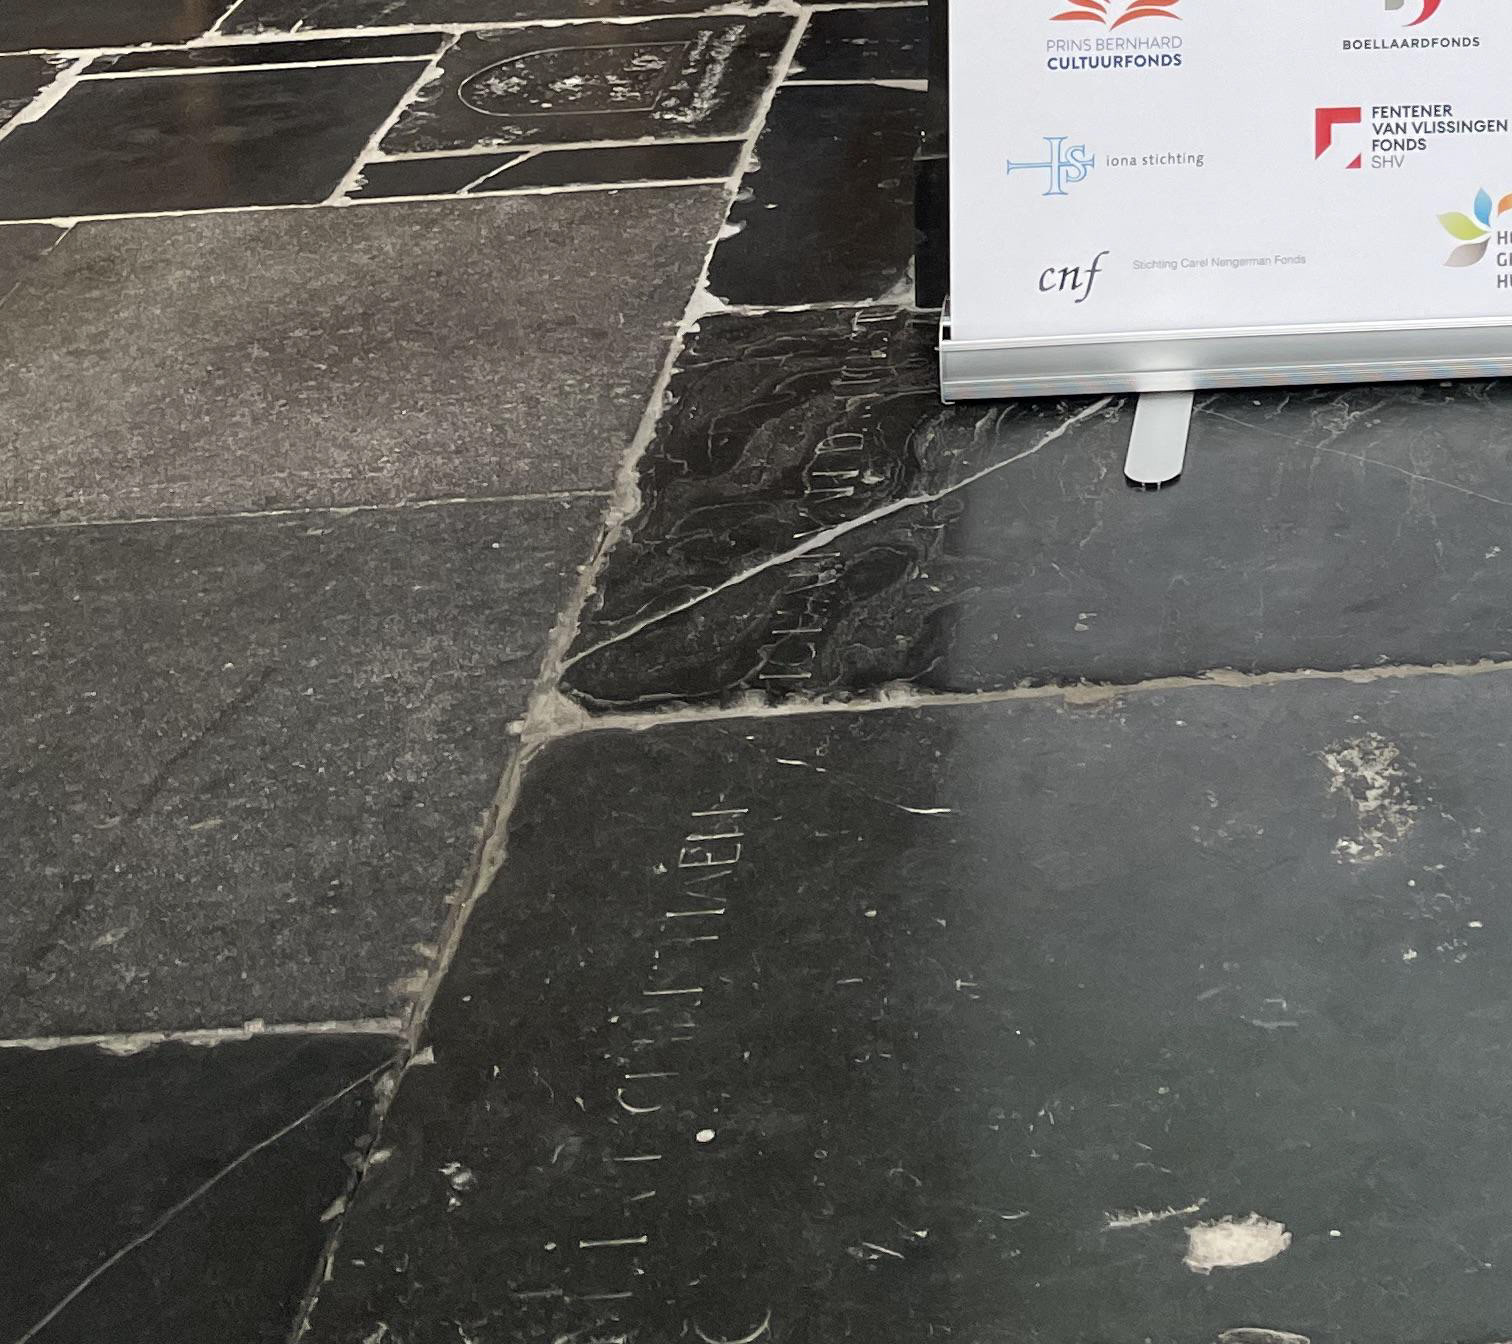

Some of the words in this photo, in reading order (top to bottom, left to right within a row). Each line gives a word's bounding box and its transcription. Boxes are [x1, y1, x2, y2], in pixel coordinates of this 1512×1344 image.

[1047, 39, 1091, 52] PRINS
[1096, 36, 1182, 51] BERNHARD
[1343, 37, 1480, 50] BOELLAARDFONDS
[1047, 54, 1182, 70] CULTUURFONDS
[1372, 105, 1453, 118] FENTENER
[1372, 122, 1407, 135] VAN
[1412, 120, 1508, 134] VLISSINGEN
[1372, 138, 1426, 152] FONDS
[1107, 155, 1137, 166] iona
[1142, 152, 1204, 167] stichting
[1371, 155, 1404, 168] SHV
[1133, 260, 1177, 270] Stichting
[1275, 255, 1306, 264] Fonds
